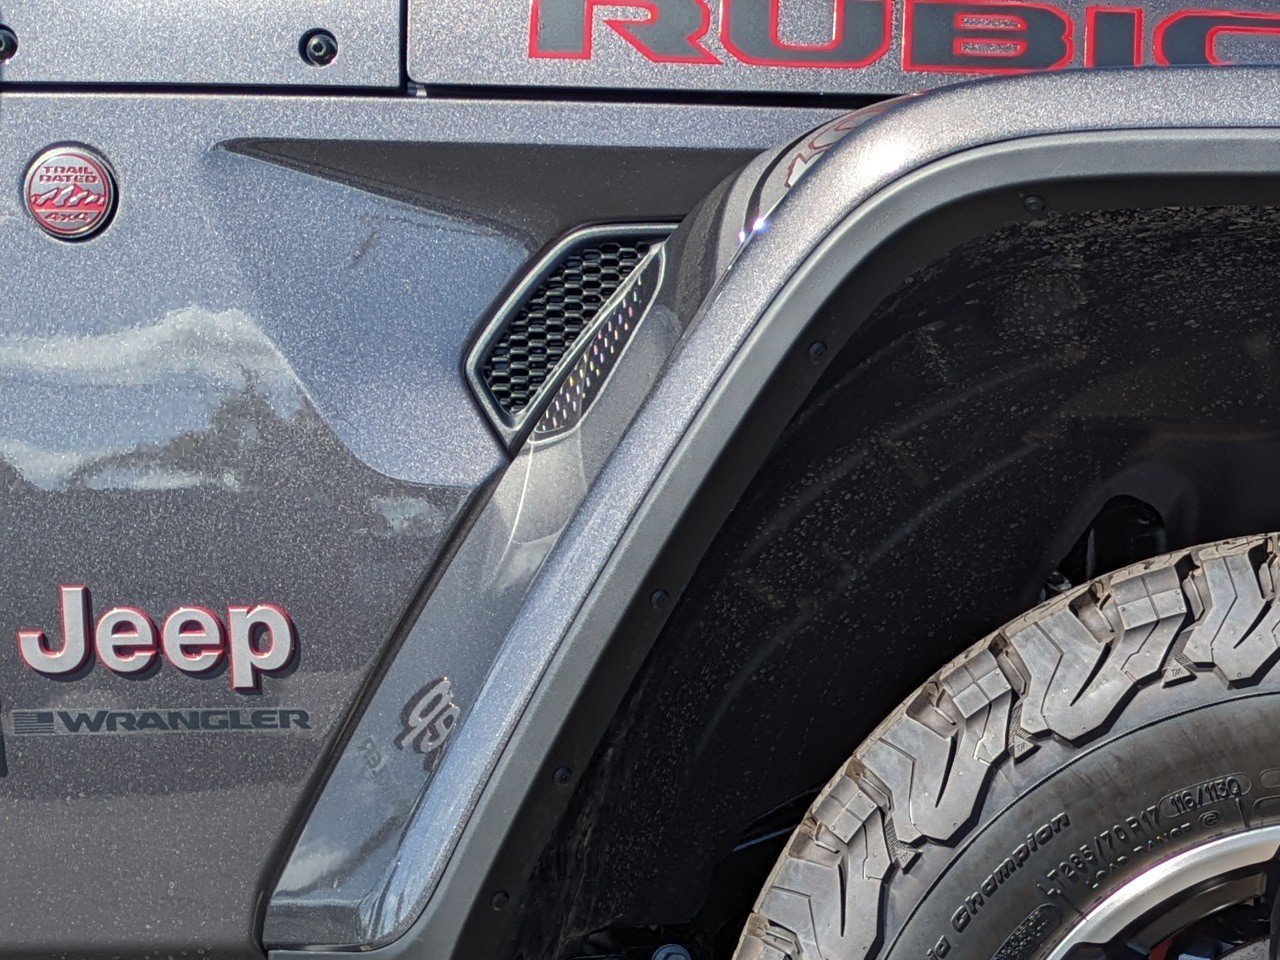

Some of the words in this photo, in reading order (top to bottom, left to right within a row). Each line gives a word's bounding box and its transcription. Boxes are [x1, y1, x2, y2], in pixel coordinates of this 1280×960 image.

[39, 175, 98, 183] RATED
[43, 166, 94, 175] TRAIL
[18, 584, 299, 690] Jeep
[56, 709, 312, 732] WRANGLER
[951, 811, 1071, 933] Champion
